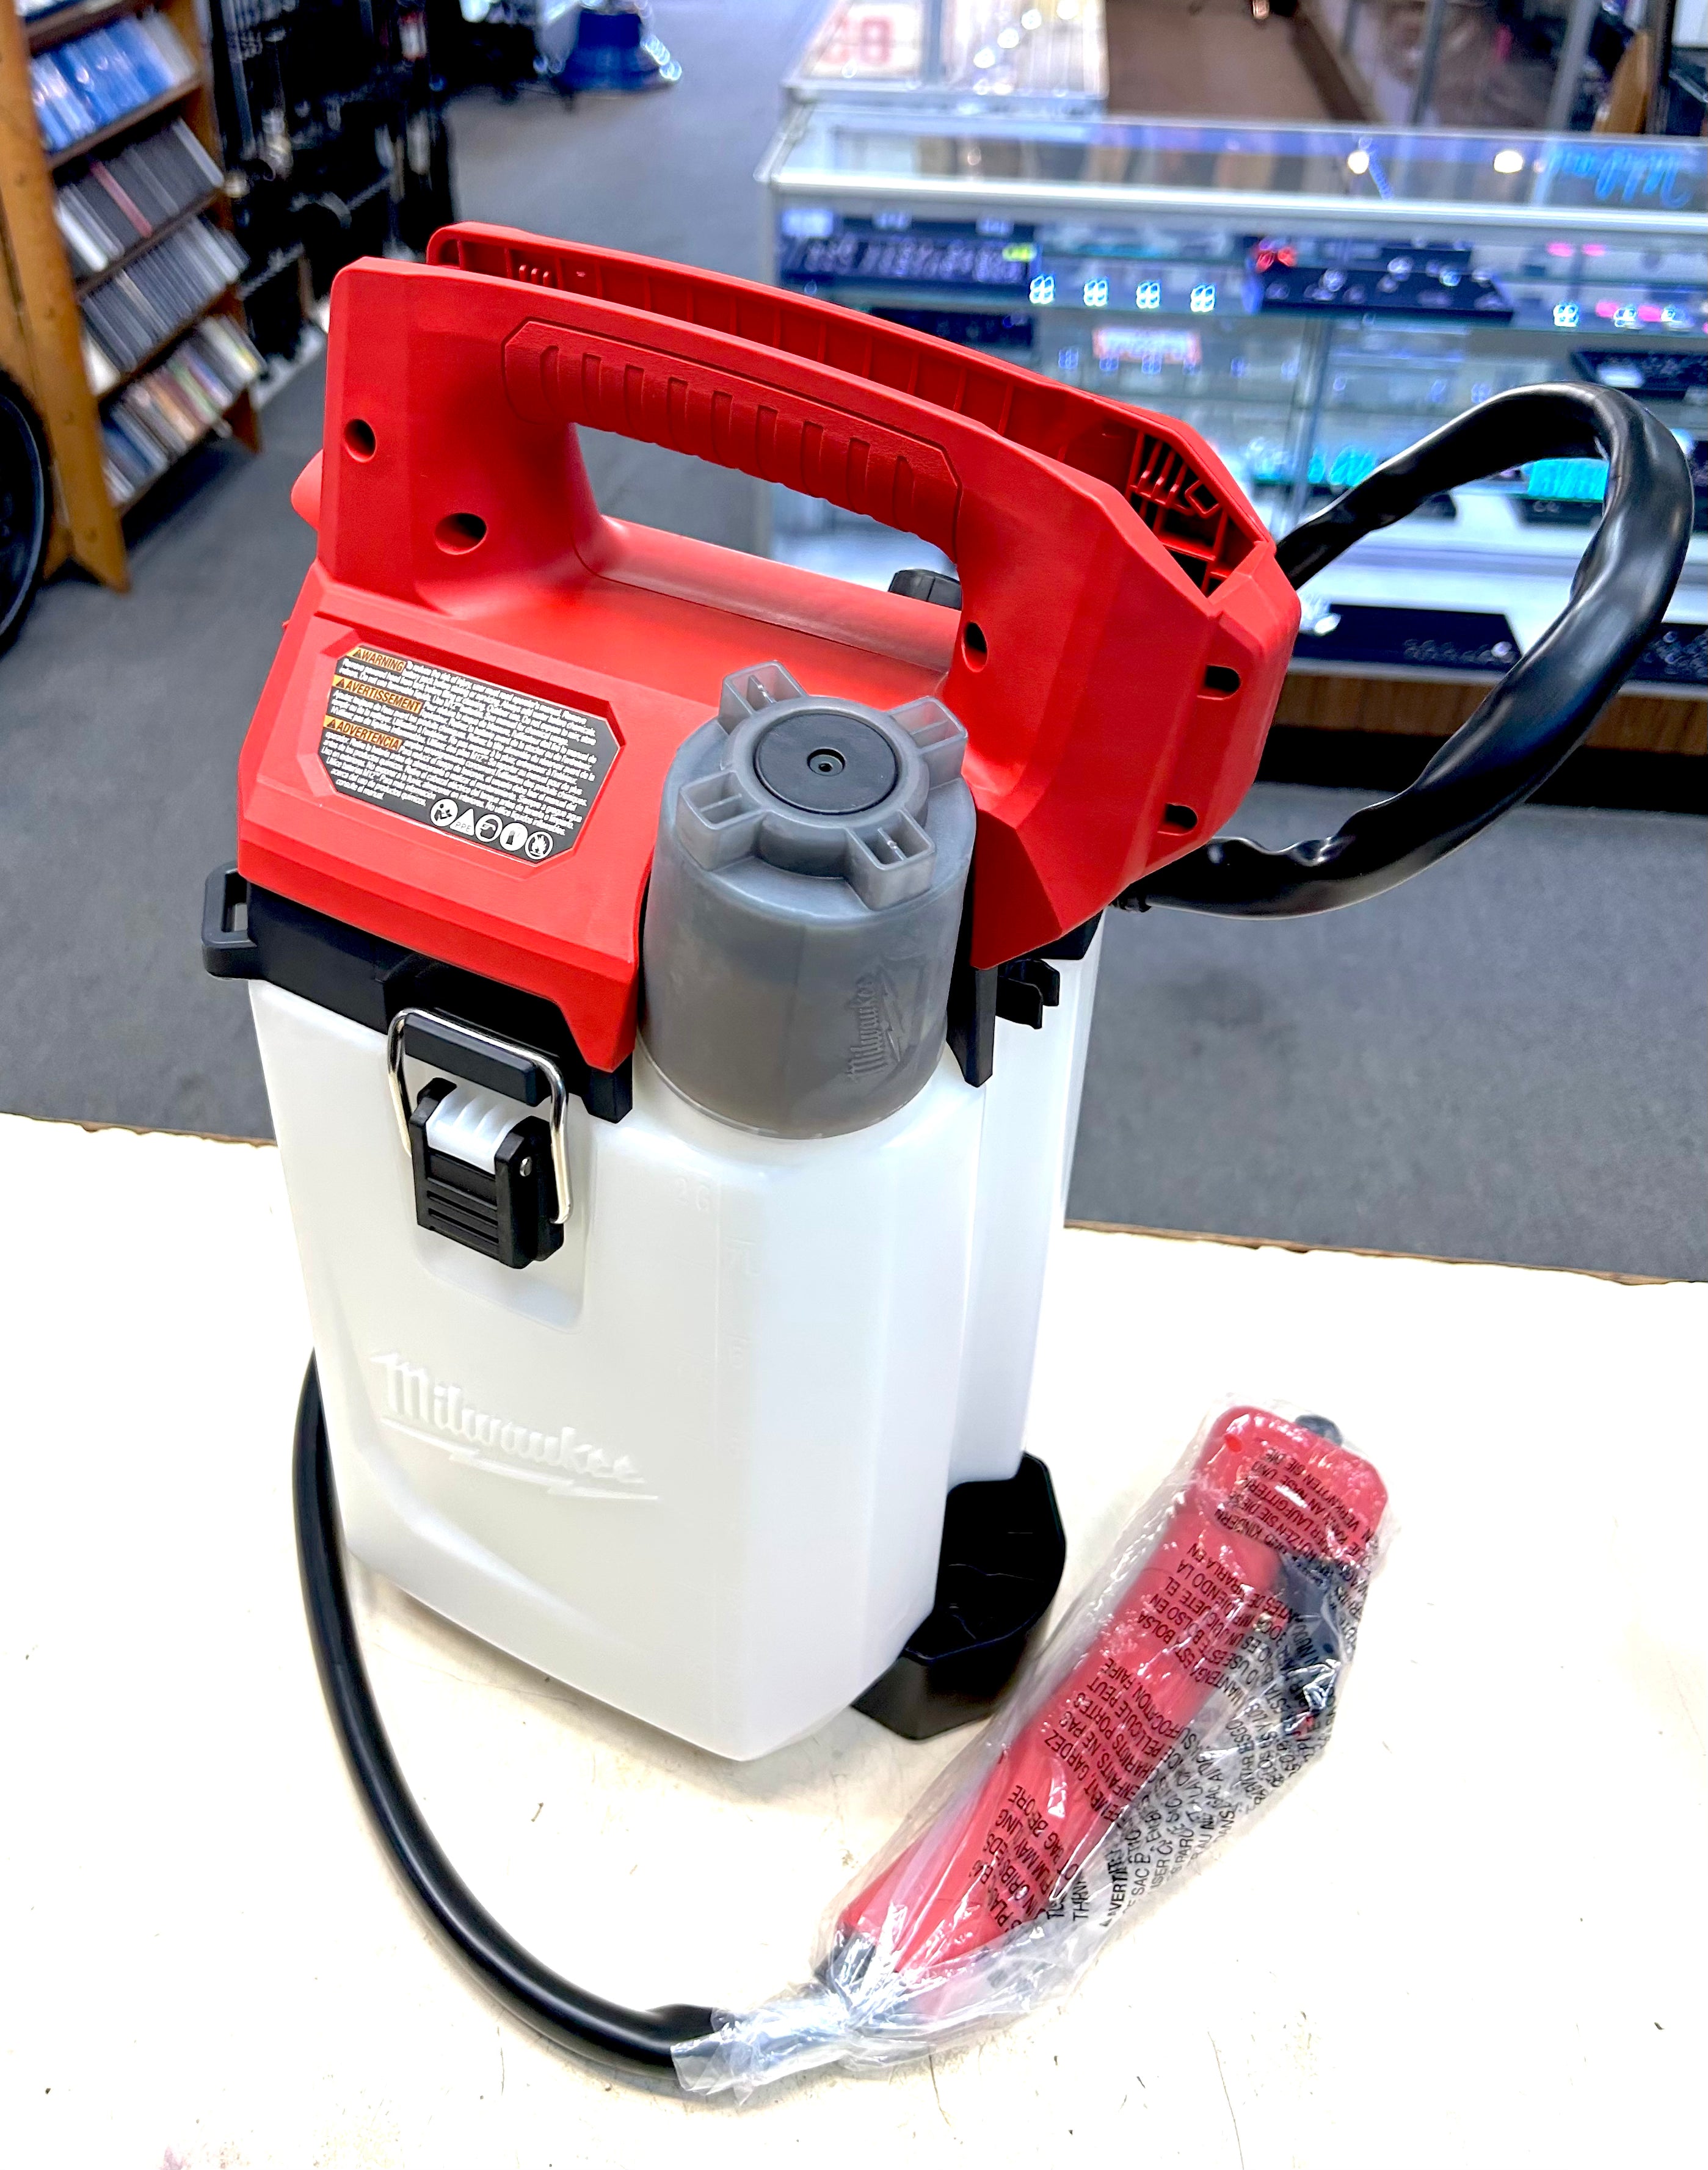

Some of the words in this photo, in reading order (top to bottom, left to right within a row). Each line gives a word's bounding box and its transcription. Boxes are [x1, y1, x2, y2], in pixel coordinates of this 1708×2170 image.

[362, 650, 404, 672] WARNING
[345, 680, 421, 712] AVERTISSEMENT
[337, 720, 400, 750] ADVERTENCIA
[370, 1352, 646, 1484] Milwaukee
[1257, 1507, 1279, 1527] SIE
[1186, 1541, 1206, 1564] EN
[1174, 1558, 1194, 1579] LA
[1161, 1573, 1180, 1595] EL
[1148, 1593, 1169, 1613] EN
[1135, 1608, 1176, 1644] BOLSA
[1164, 1602, 1205, 1644] BOLSO
[1087, 1673, 1119, 1707] PEUT
[1044, 1728, 1091, 1780] GARDEZ
[1081, 1731, 1102, 1755] NE
[1012, 1837, 1041, 1867] MAY
